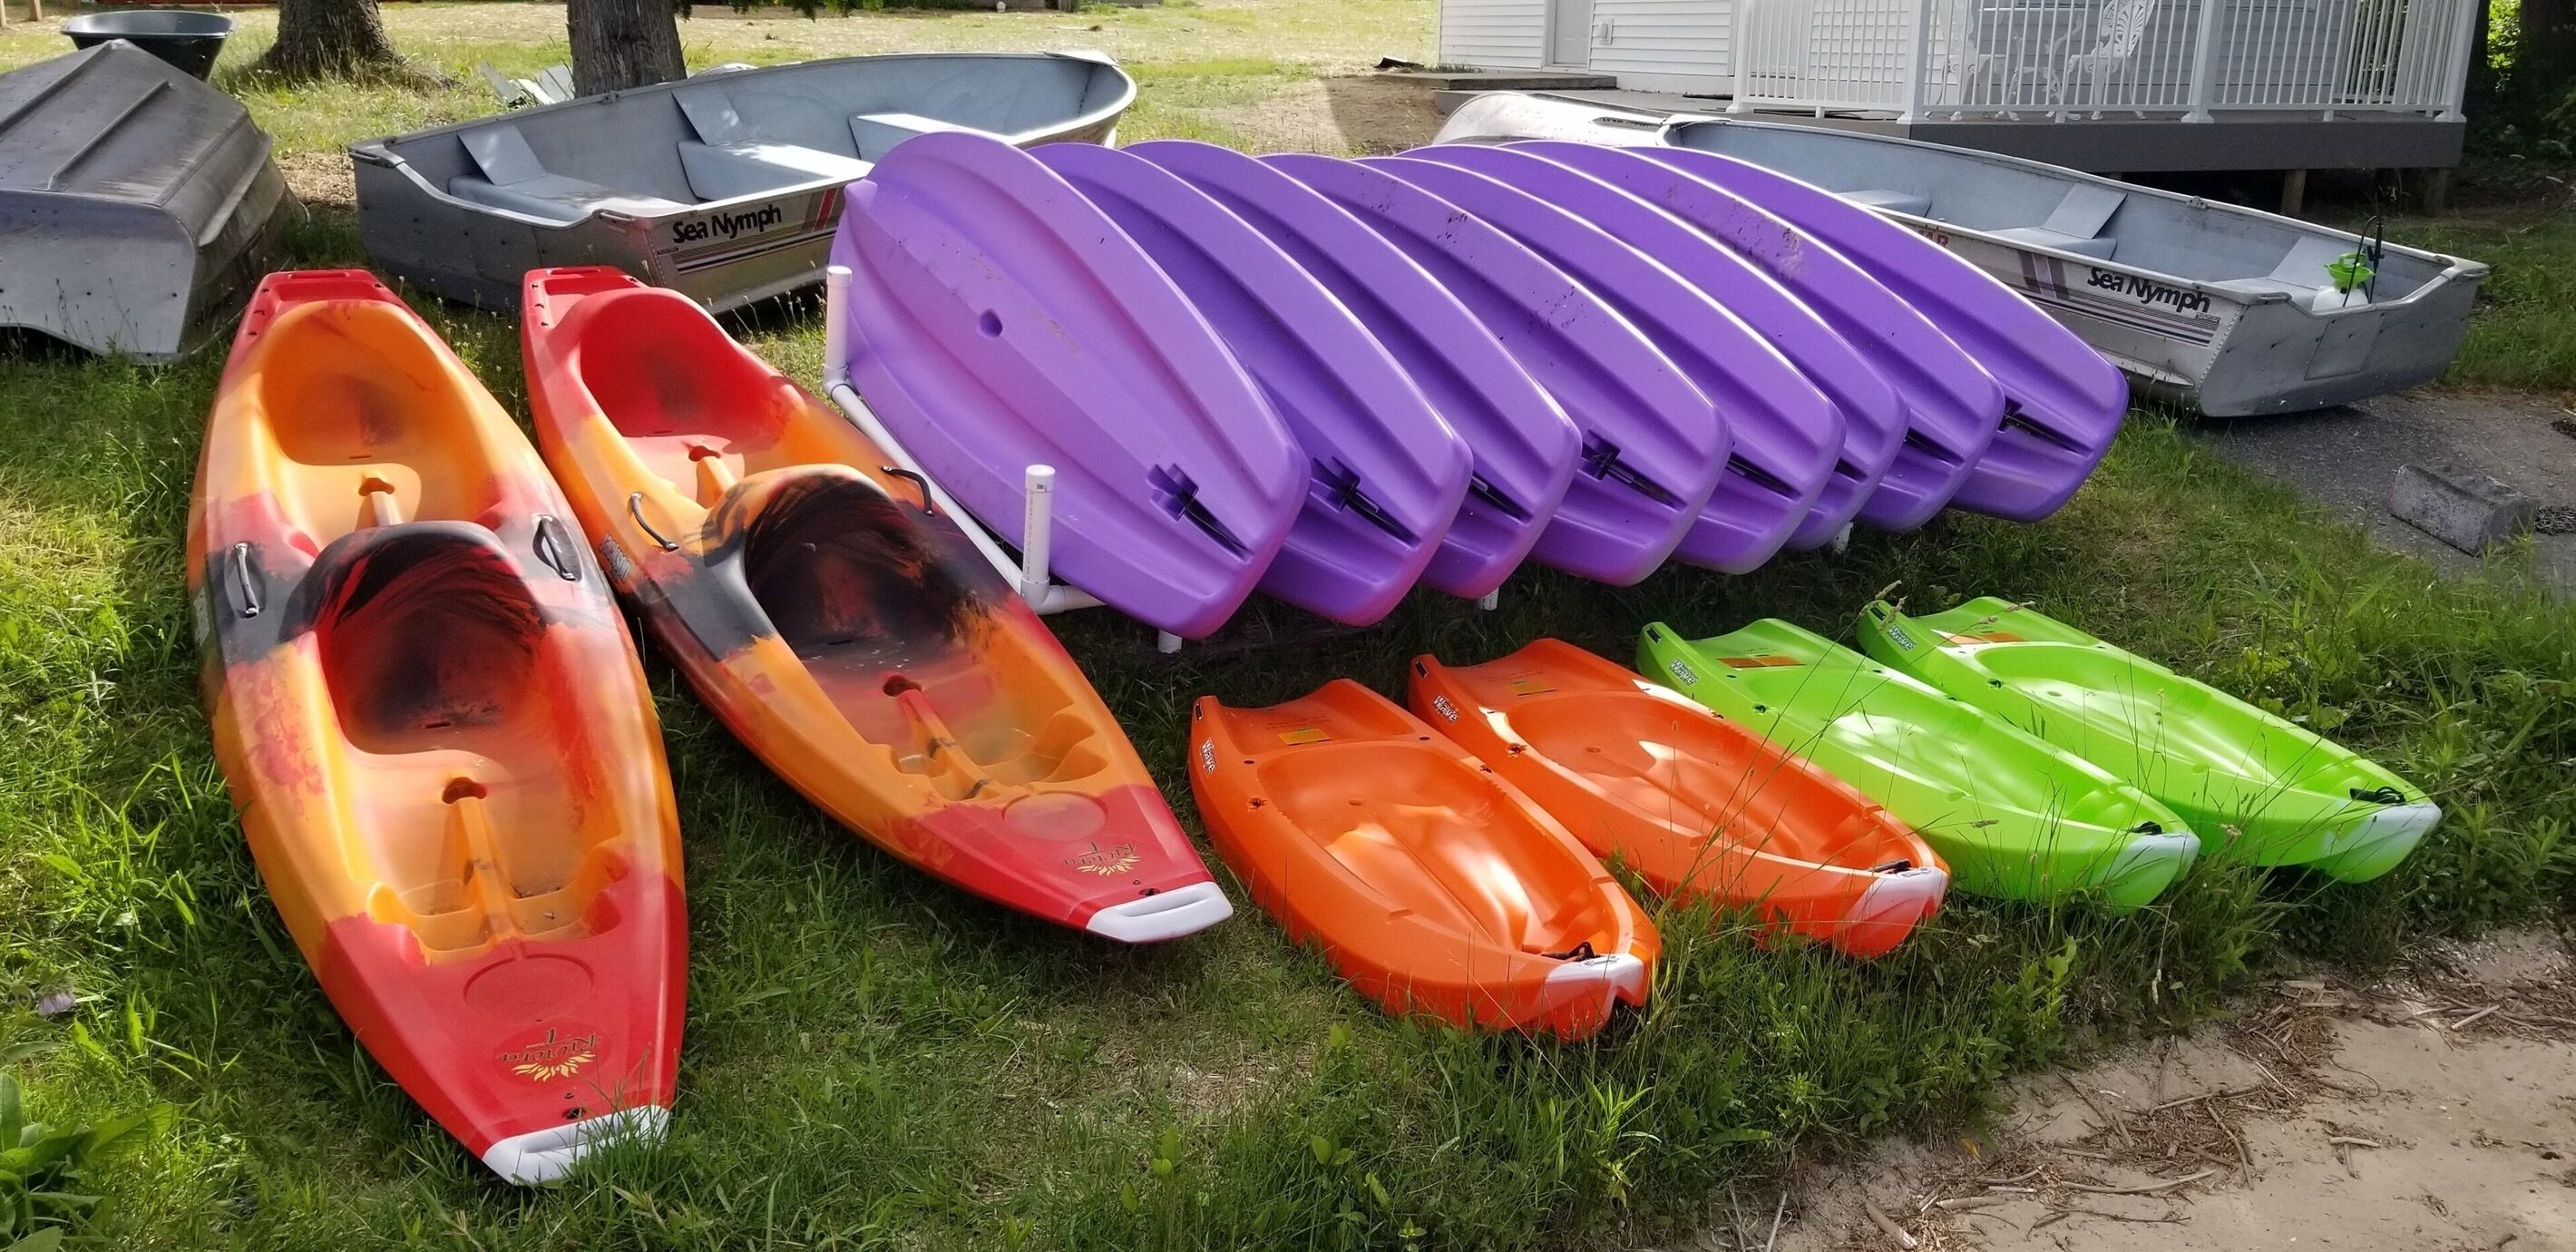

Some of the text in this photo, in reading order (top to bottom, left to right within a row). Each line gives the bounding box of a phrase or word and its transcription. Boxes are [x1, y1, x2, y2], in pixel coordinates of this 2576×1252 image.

[672, 203, 783, 243] Sea Nymph
[2087, 267, 2211, 314] Sea Nymph
[1888, 624, 1915, 650] Wave
[1669, 659, 1697, 685] Wave
[1433, 694, 1459, 721] Wave
[1202, 738, 1216, 774] Wave
